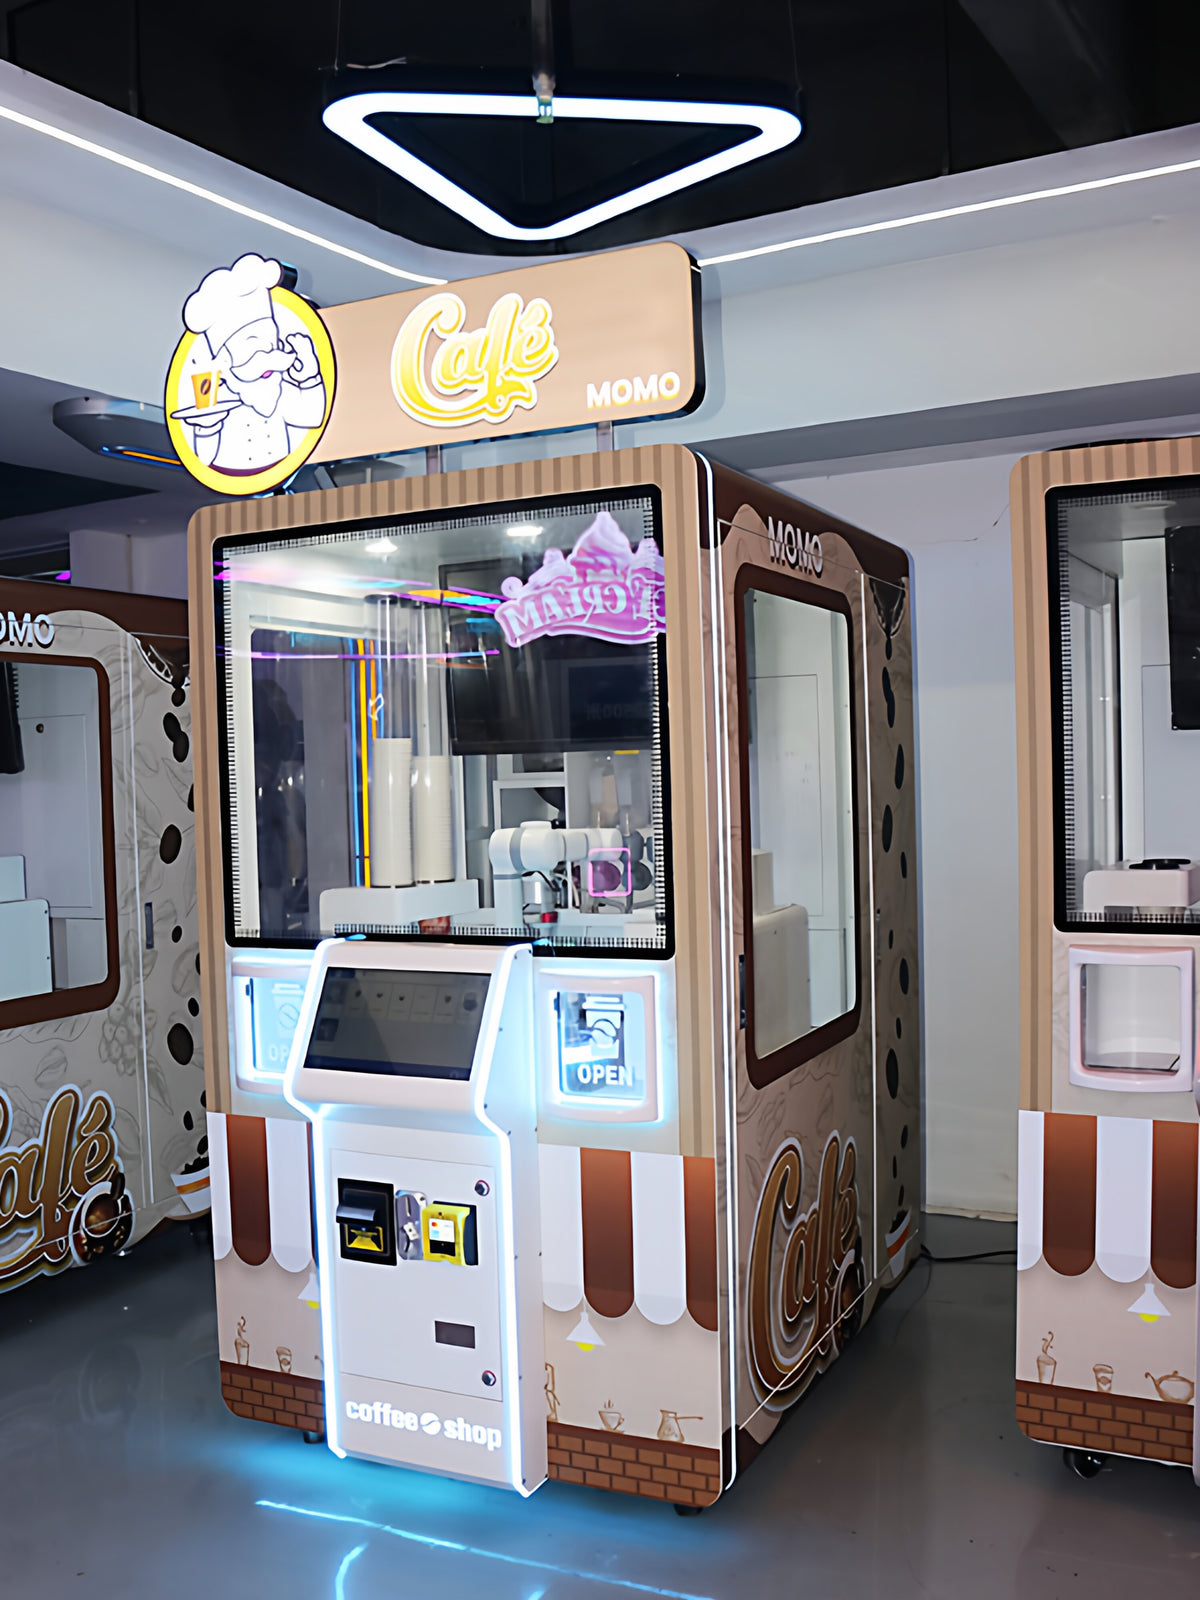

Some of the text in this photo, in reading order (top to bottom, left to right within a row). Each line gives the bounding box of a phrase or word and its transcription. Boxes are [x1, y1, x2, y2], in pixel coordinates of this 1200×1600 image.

[391, 292, 559, 427] Café
[586, 371, 681, 410] MOMO
[767, 515, 823, 577] MOMO
[577, 1063, 634, 1087] OPEN
[345, 1400, 502, 1452] coffee shop
